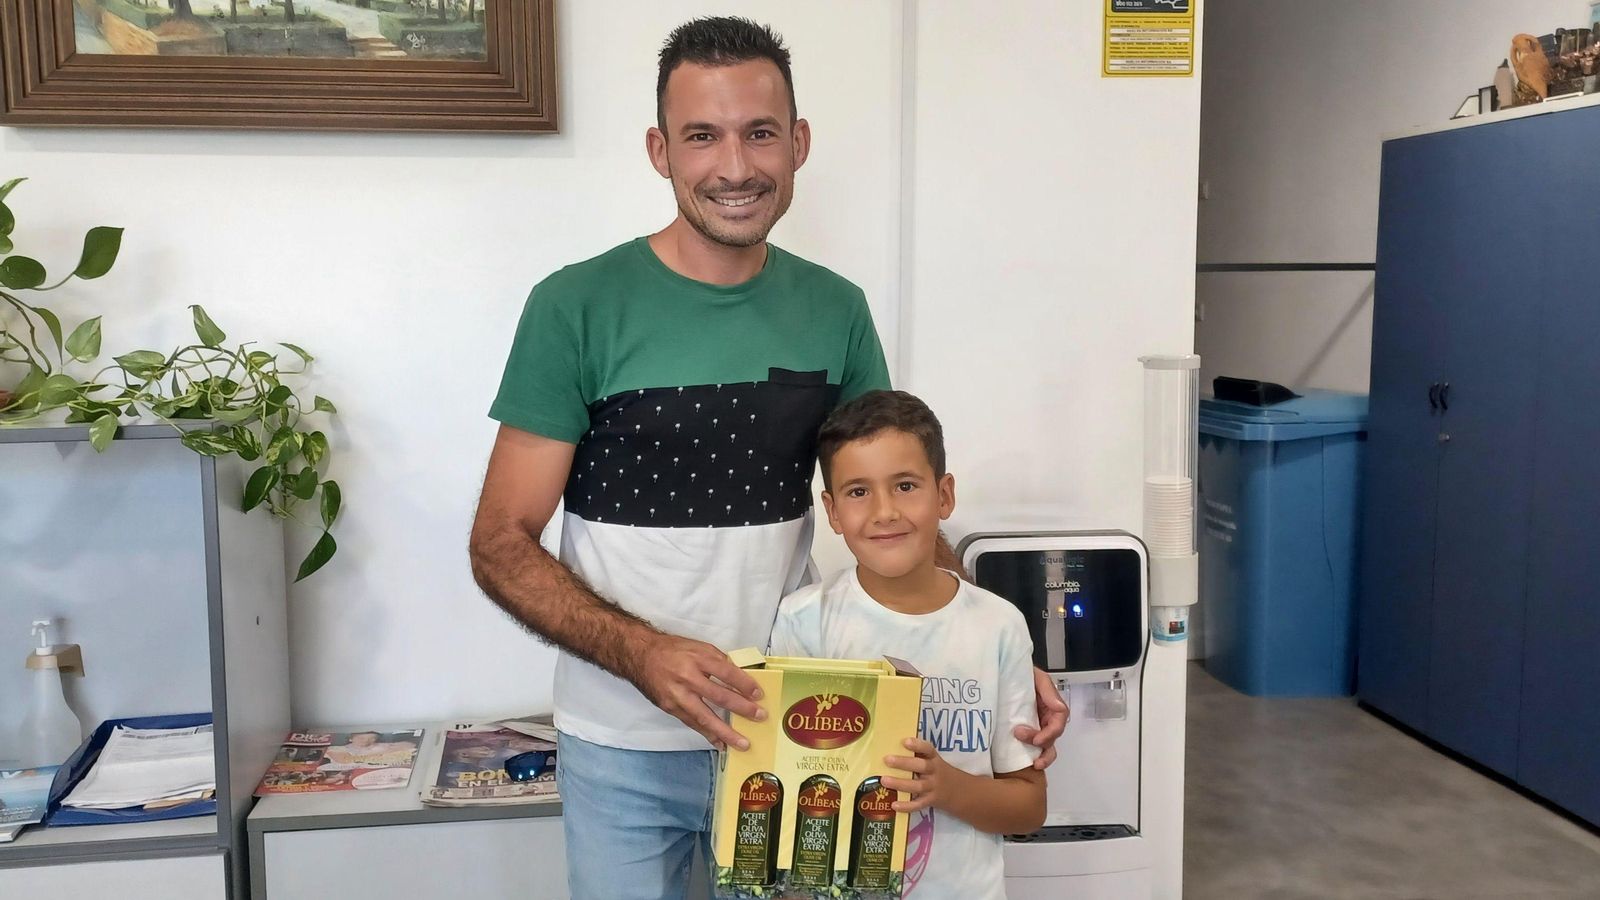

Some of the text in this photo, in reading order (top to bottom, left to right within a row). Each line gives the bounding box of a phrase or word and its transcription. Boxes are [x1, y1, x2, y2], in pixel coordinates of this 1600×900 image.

[1045, 580, 1080, 588] columbia
[918, 708, 992, 752] MAN
[796, 761, 850, 772] VIRGEN EXTRA
[860, 800, 892, 811] OLIBE
[741, 812, 767, 820] ACEITE
[805, 818, 830, 826] ACEITE
[738, 831, 766, 839] VIRGEN
[804, 831, 827, 839] OLIVA
[801, 836, 829, 845] VIRGEN
[864, 840, 891, 848] VIRGEN
